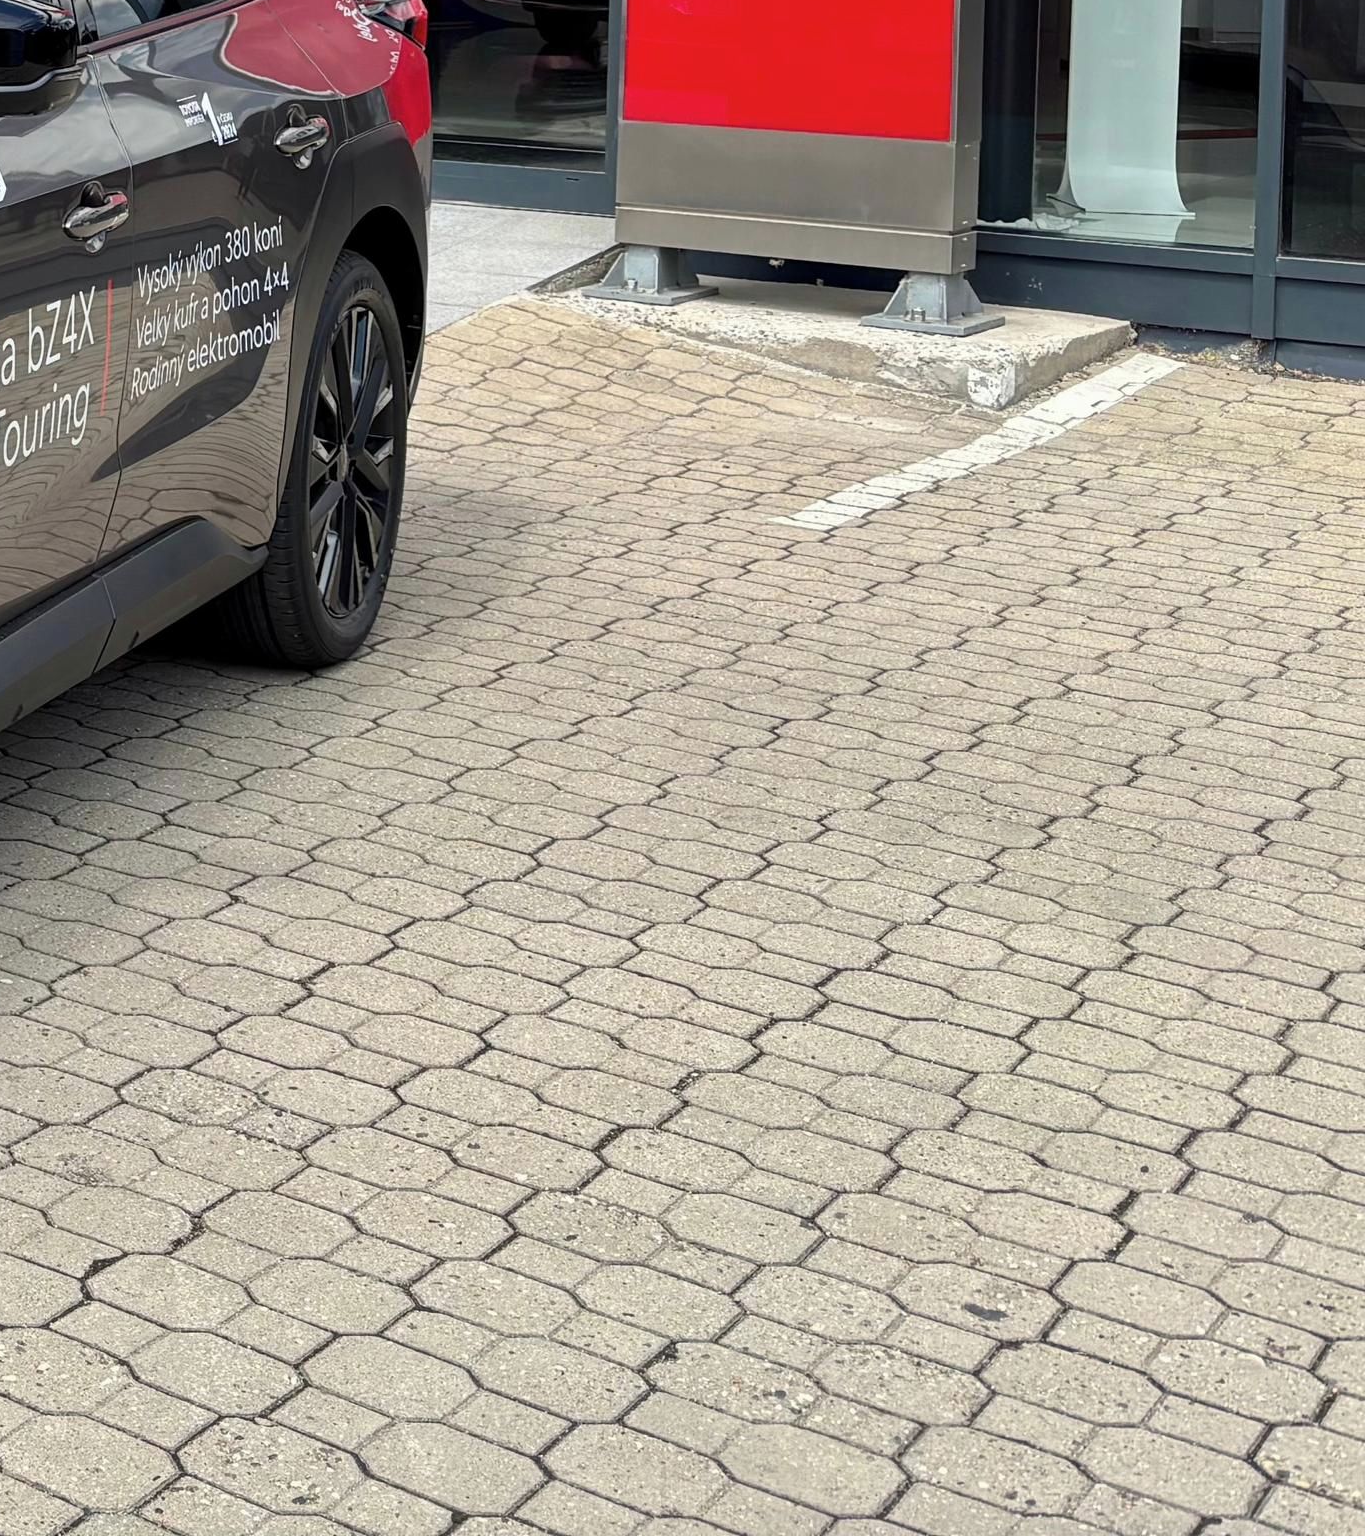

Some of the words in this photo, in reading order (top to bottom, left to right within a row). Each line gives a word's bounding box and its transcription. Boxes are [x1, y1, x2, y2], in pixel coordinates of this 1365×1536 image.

[137, 250, 184, 305] Vysoký
[186, 241, 221, 284] výkon
[225, 226, 250, 263] 380
[254, 216, 283, 254] koní
[28, 286, 96, 373] bZ4X
[130, 344, 185, 401] Rodinný
[187, 309, 281, 372] elektromobil
[136, 304, 171, 349] Velký
[173, 292, 199, 332] kufr
[200, 297, 209, 320] a
[213, 276, 260, 323] pohon
